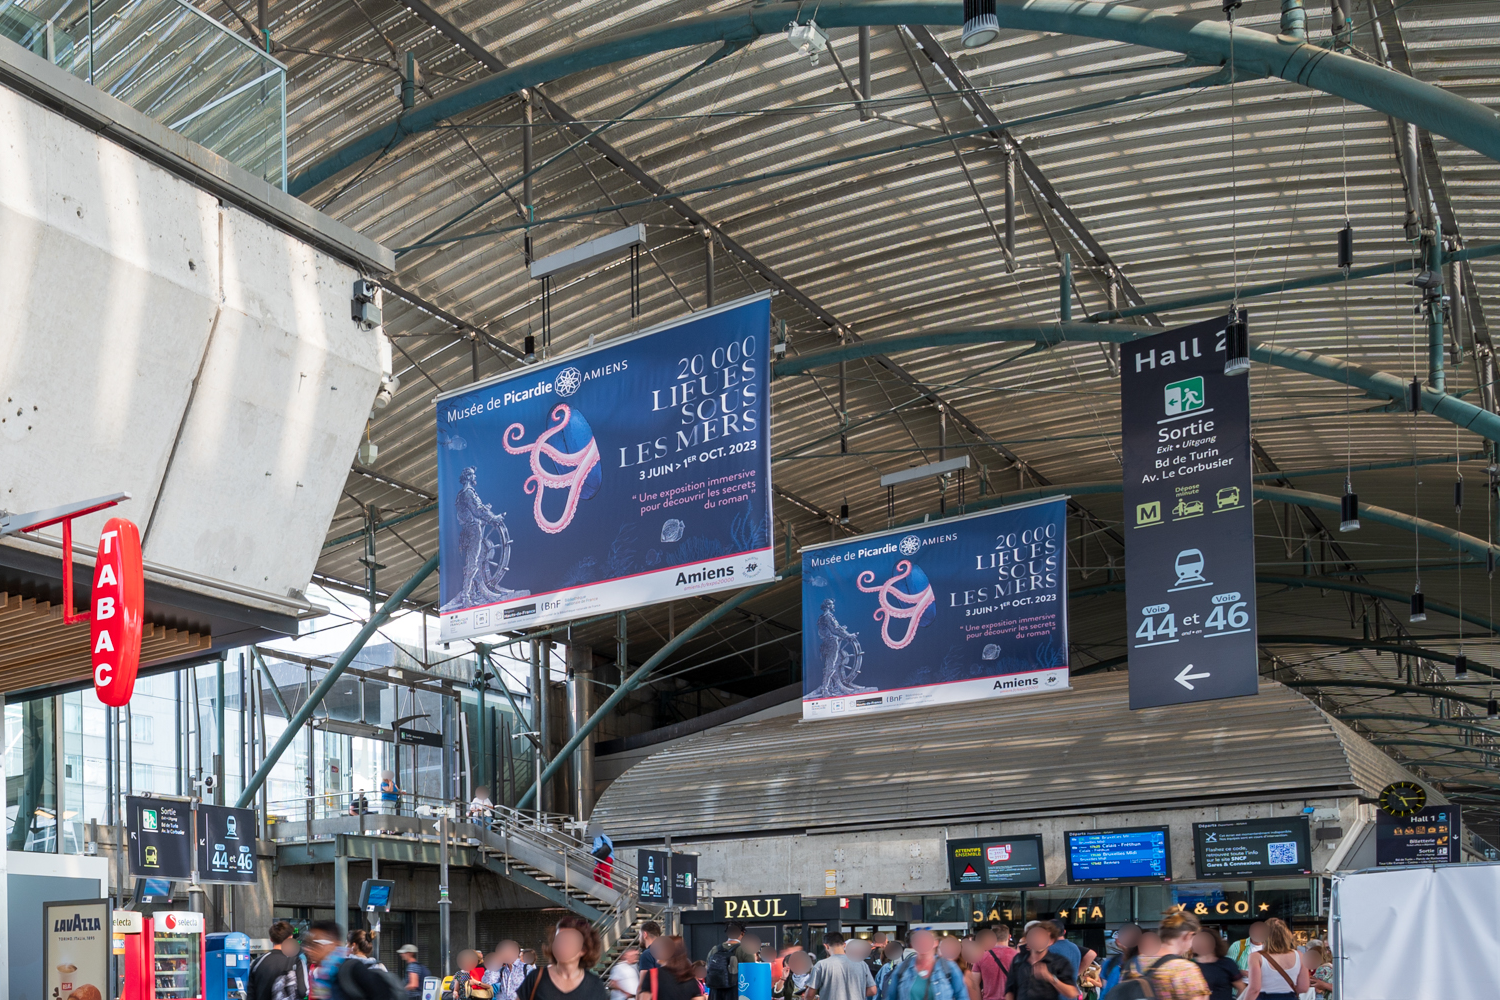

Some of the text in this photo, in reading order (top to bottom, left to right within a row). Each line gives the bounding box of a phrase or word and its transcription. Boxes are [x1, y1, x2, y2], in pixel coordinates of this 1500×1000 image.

[676, 335, 756, 380] 20 000
[1135, 337, 1202, 373] Hall
[447, 359, 628, 423] Musée de Picardie AMIENS
[651, 358, 756, 412] LIEUES
[681, 383, 757, 425] SOUS
[618, 409, 757, 468] LES MERS
[1158, 419, 1215, 443] Sortie
[1156, 434, 1217, 454] Exit Uitgang
[639, 439, 757, 481] 3 JUIN 1ER OCT. 2023
[1155, 447, 1219, 469] Bd de Turin
[1141, 456, 1234, 484] Av. Le Corbusier
[639, 468, 756, 503] Une exposition immersive
[1175, 483, 1200, 493] Dépose
[1175, 488, 1200, 498] minute
[640, 480, 756, 516] pour découvrir les secrets
[704, 493, 749, 510] du roman
[1140, 505, 1157, 521] M
[995, 523, 1056, 550] 20 000
[811, 532, 958, 568] Musée de Picardie AMIENS
[975, 538, 1056, 571] LIEUES
[675, 565, 734, 586] Amiens
[998, 555, 1057, 581] SOUS
[949, 572, 1057, 608] LES MERS
[94, 530, 118, 687] TABAC
[965, 609, 971, 617] 3
[971, 605, 993, 617] JUIN
[1012, 597, 1034, 607] OCT.
[1035, 593, 1057, 604] 2023
[1145, 593, 1237, 614] Voie Voie
[965, 612, 1056, 632] Une exposition immersive
[966, 620, 1056, 641] pour découvrir les secrets
[1135, 601, 1249, 642] 44 et 46
[1015, 629, 1051, 639] du roman
[993, 677, 1039, 690] Amiens
[160, 806, 177, 816] Sortie
[212, 851, 253, 870] 44 et 46
[641, 881, 650, 894] 44
[653, 882, 662, 895] 46
[724, 898, 788, 919] PAUL
[871, 898, 894, 917] PAUL
[1194, 900, 1249, 915] & CO
[54, 913, 102, 933] LAVAZZA
[177, 918, 198, 927] selecta
